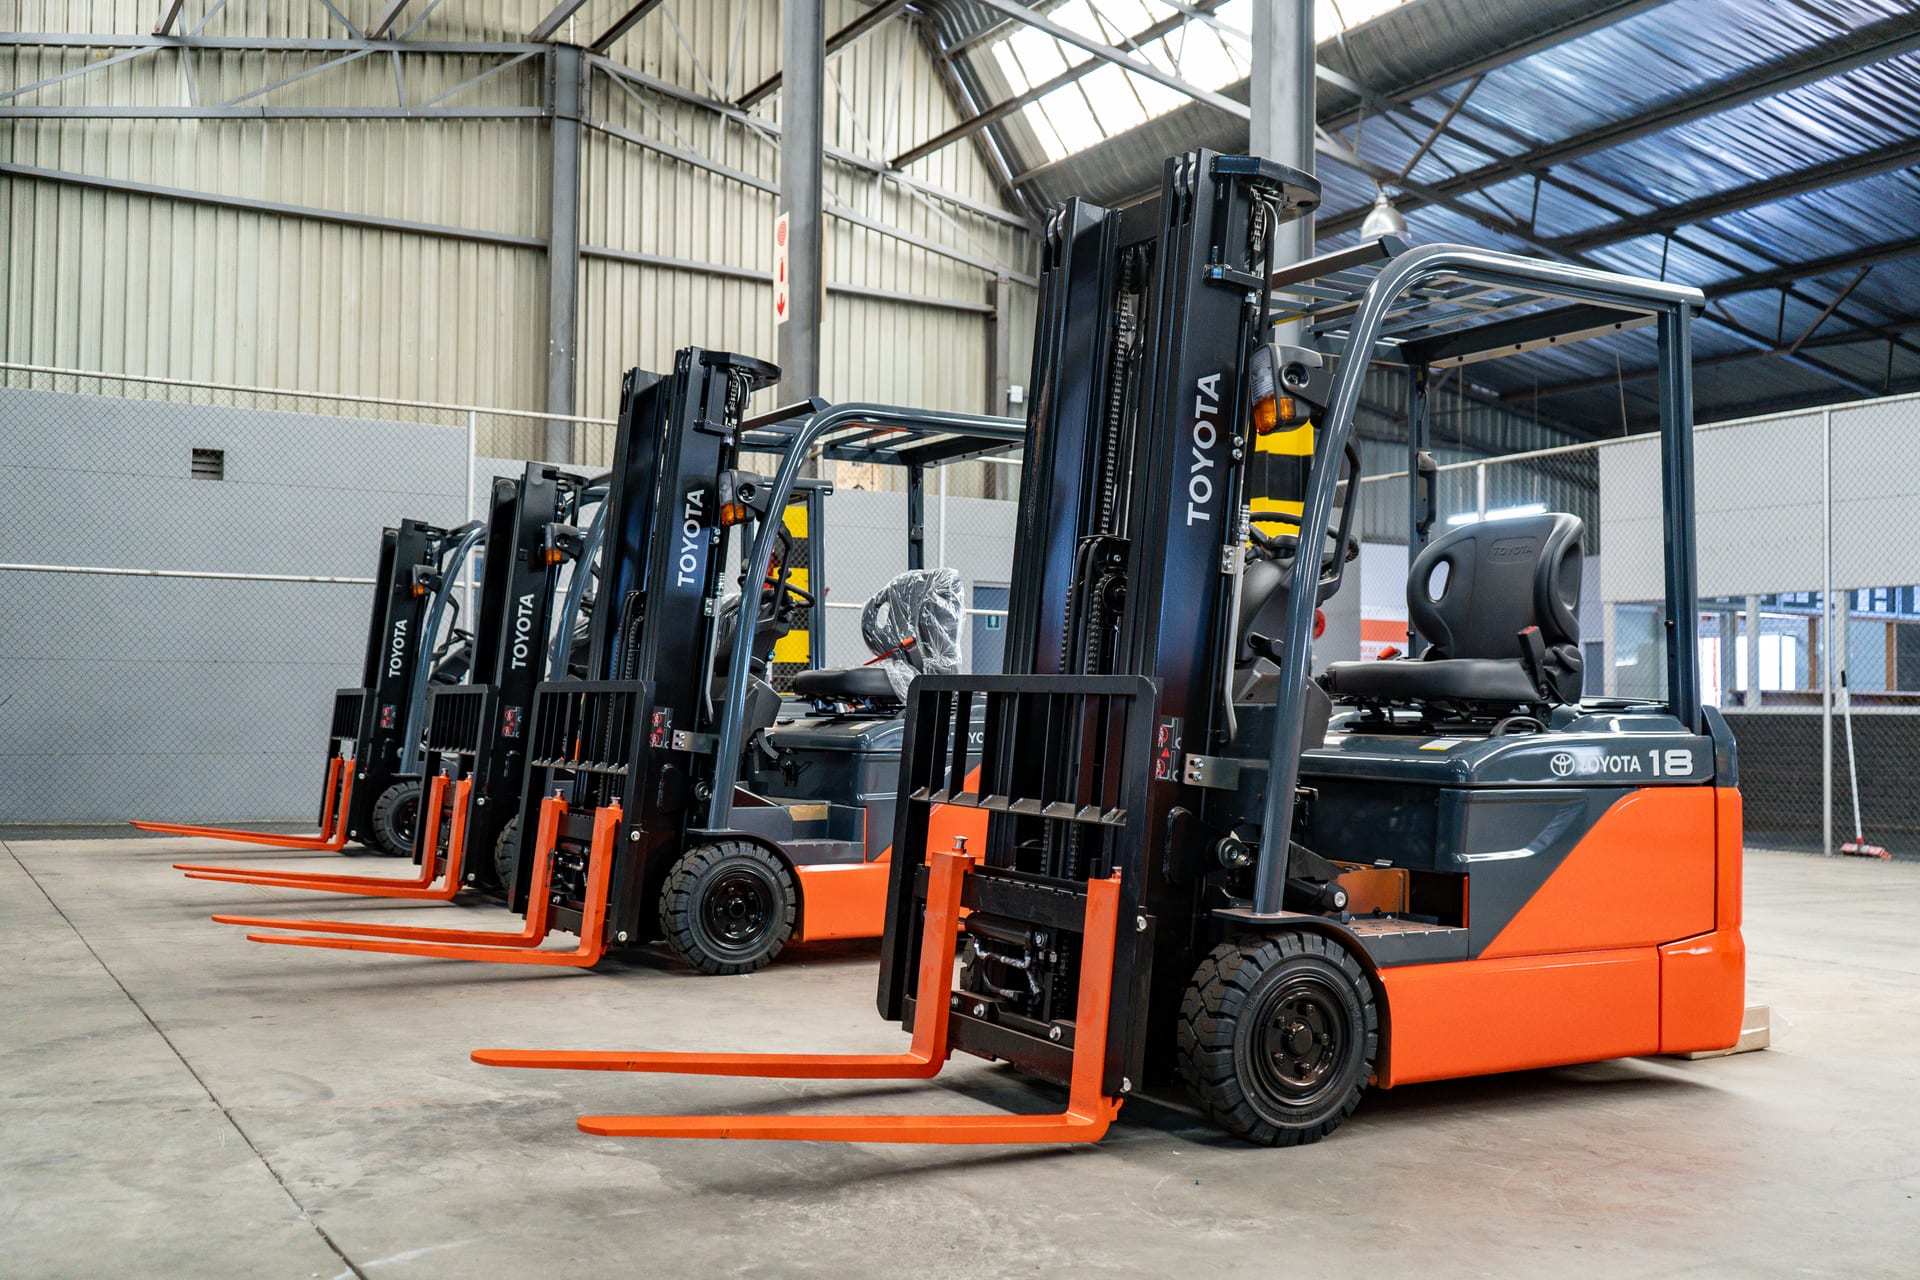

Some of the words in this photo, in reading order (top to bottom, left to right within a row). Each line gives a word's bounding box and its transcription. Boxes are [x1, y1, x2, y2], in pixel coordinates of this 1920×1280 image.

[1187, 373, 1221, 526] TOYOTA
[677, 489, 705, 587] TOYOTA
[388, 619, 408, 678] TOYOTA
[512, 593, 535, 669] TOYOTA
[1577, 755, 1642, 773] TOYOTA
[1648, 749, 1693, 776] 18
